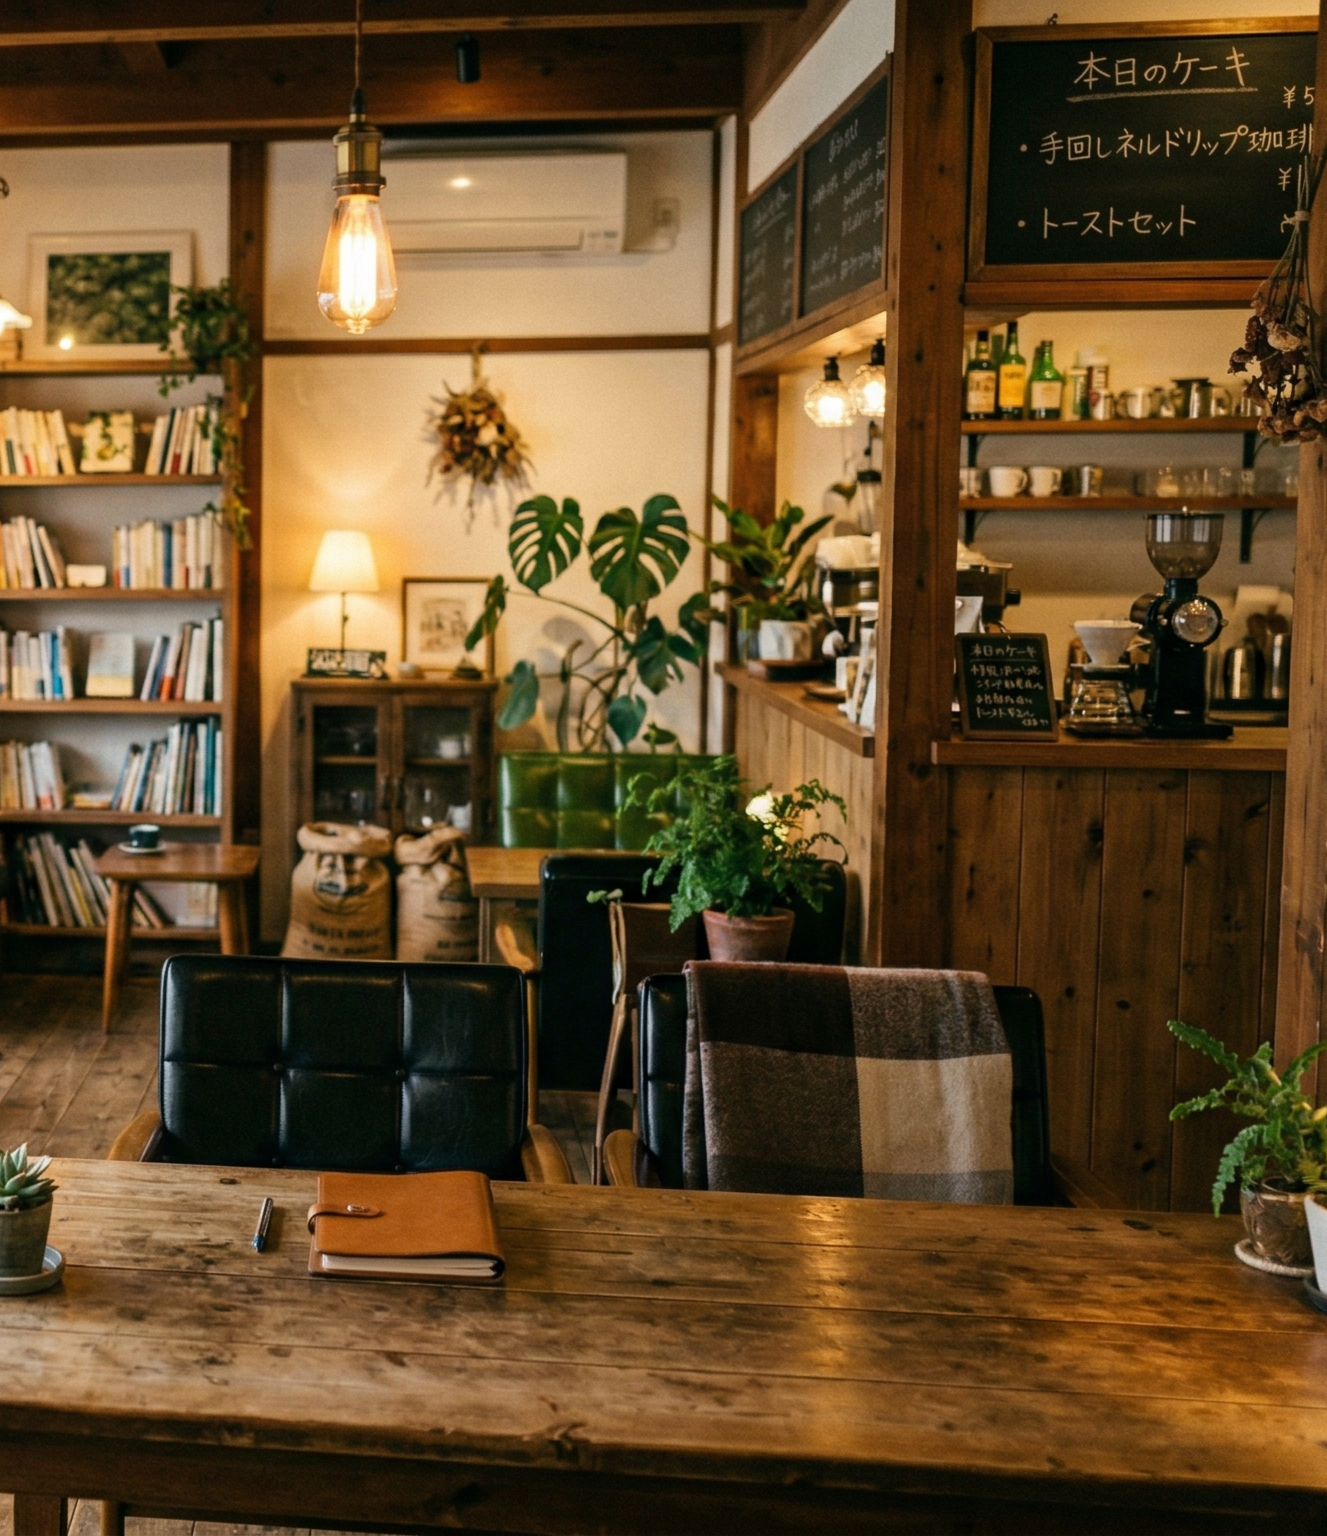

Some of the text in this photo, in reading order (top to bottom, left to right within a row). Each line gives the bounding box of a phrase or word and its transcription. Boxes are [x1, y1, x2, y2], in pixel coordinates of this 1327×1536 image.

[1073, 46, 1250, 90] 本日のケーキ
[1039, 123, 1314, 164] 手回しネルドリップ珈琲
[1043, 204, 1196, 239] トーストセット
